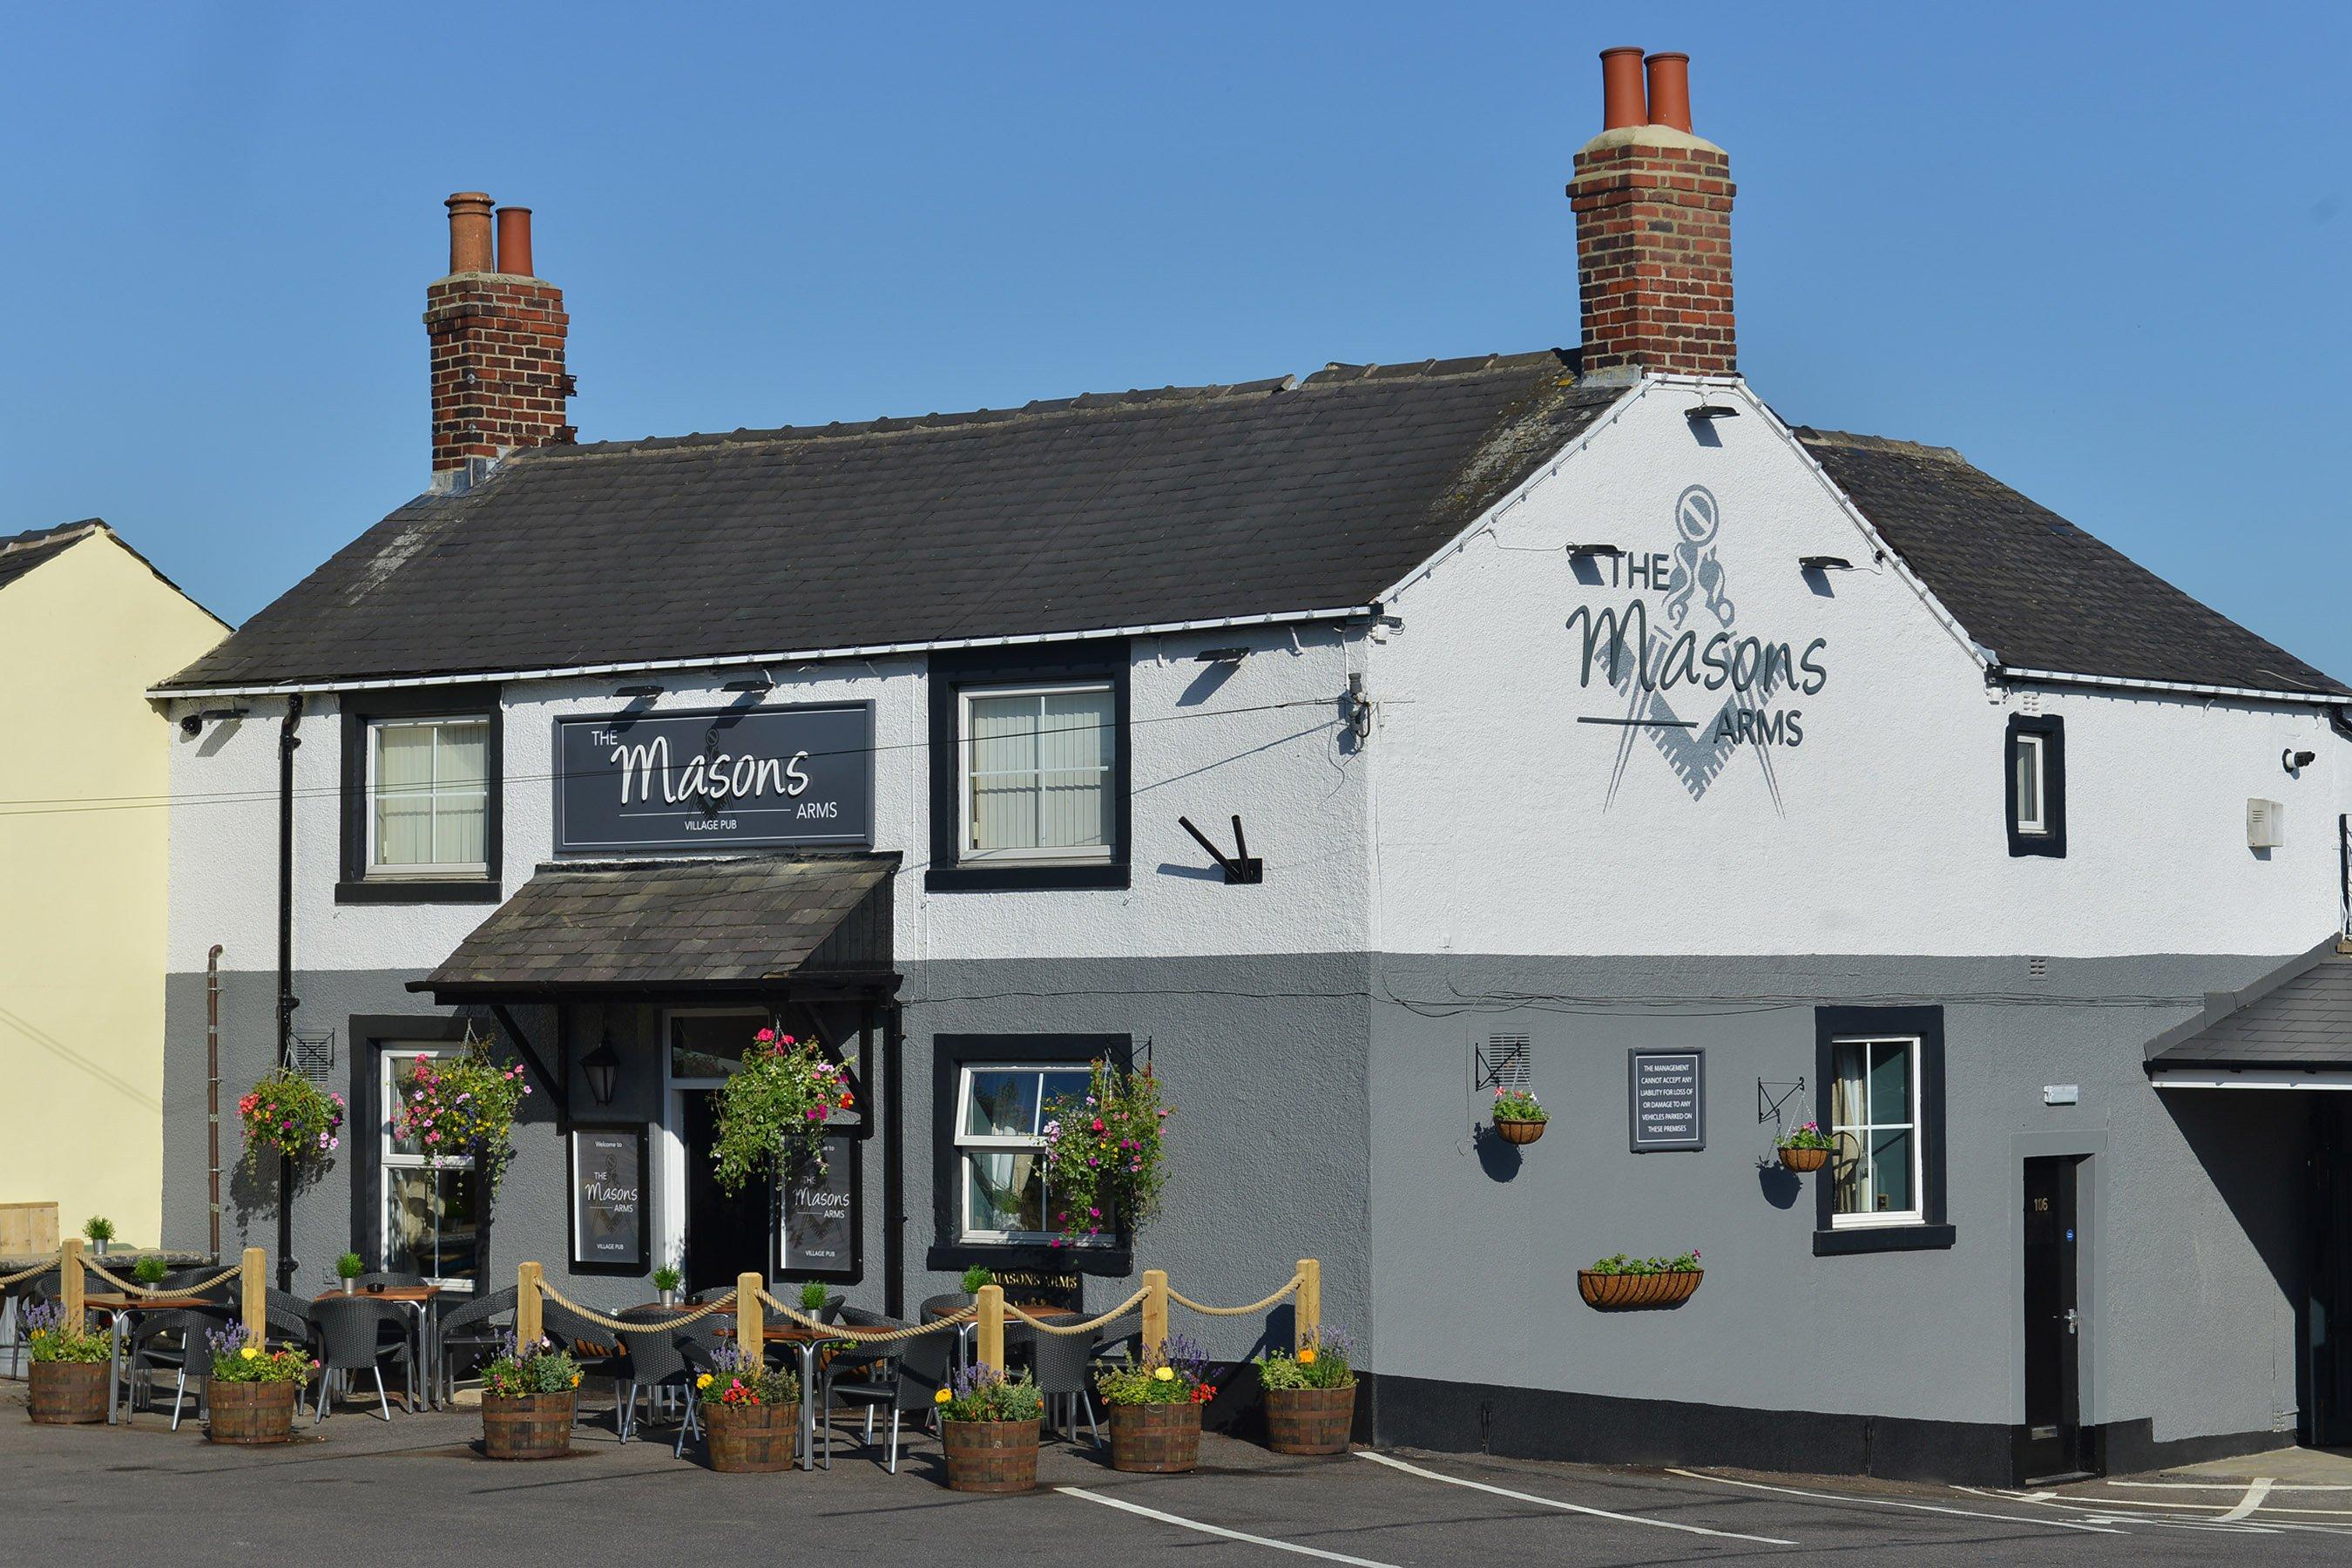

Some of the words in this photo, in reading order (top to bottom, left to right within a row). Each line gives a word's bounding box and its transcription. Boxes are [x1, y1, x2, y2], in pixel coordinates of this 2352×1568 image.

[1612, 551, 1671, 591] THE
[1566, 598, 1827, 694] Masons
[1713, 708, 1803, 746] ARMS
[591, 730, 618, 746] THE
[611, 736, 808, 804] Masons
[796, 802, 837, 820] ARMS
[685, 821, 719, 831] VILLAGE
[720, 820, 737, 829] PUB
[594, 1172, 607, 1180] THE
[802, 1176, 816, 1185] THE
[585, 1182, 638, 1201] Masons
[793, 1187, 849, 1206] Masons
[2034, 1198, 2048, 1211] 106
[823, 1210, 845, 1219] ARMS
[991, 1272, 1040, 1286] MASONS
